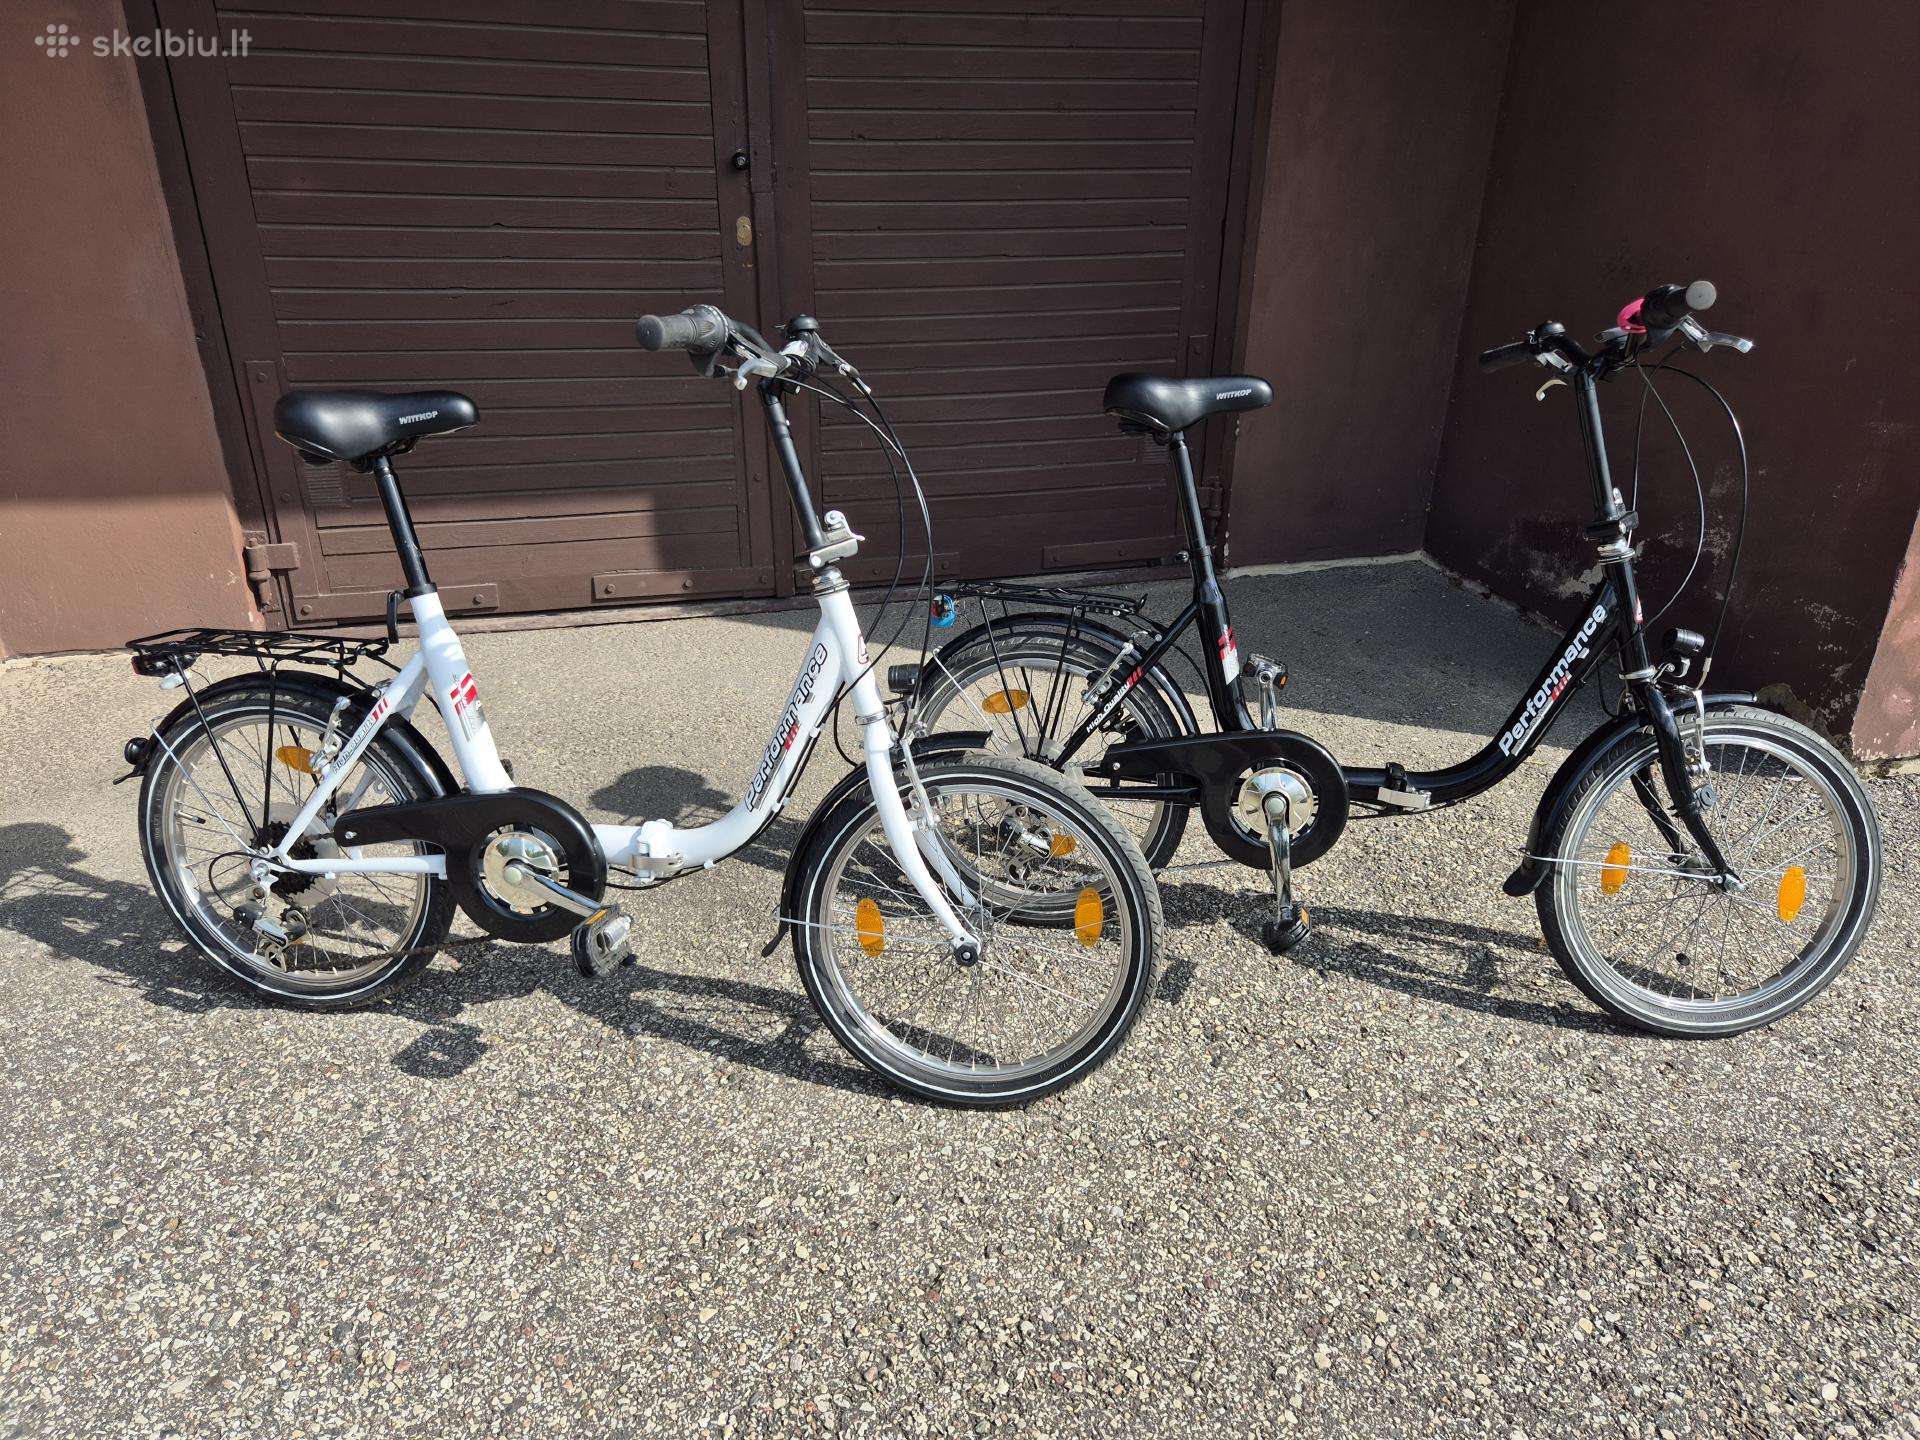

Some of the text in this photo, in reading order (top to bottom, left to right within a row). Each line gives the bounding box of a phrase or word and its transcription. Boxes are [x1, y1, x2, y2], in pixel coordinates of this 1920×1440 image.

[399, 410, 438, 424] WITTKOP
[1216, 389, 1252, 400] WITTKOP
[1498, 604, 1606, 757] Performance
[745, 643, 828, 812] Performance
